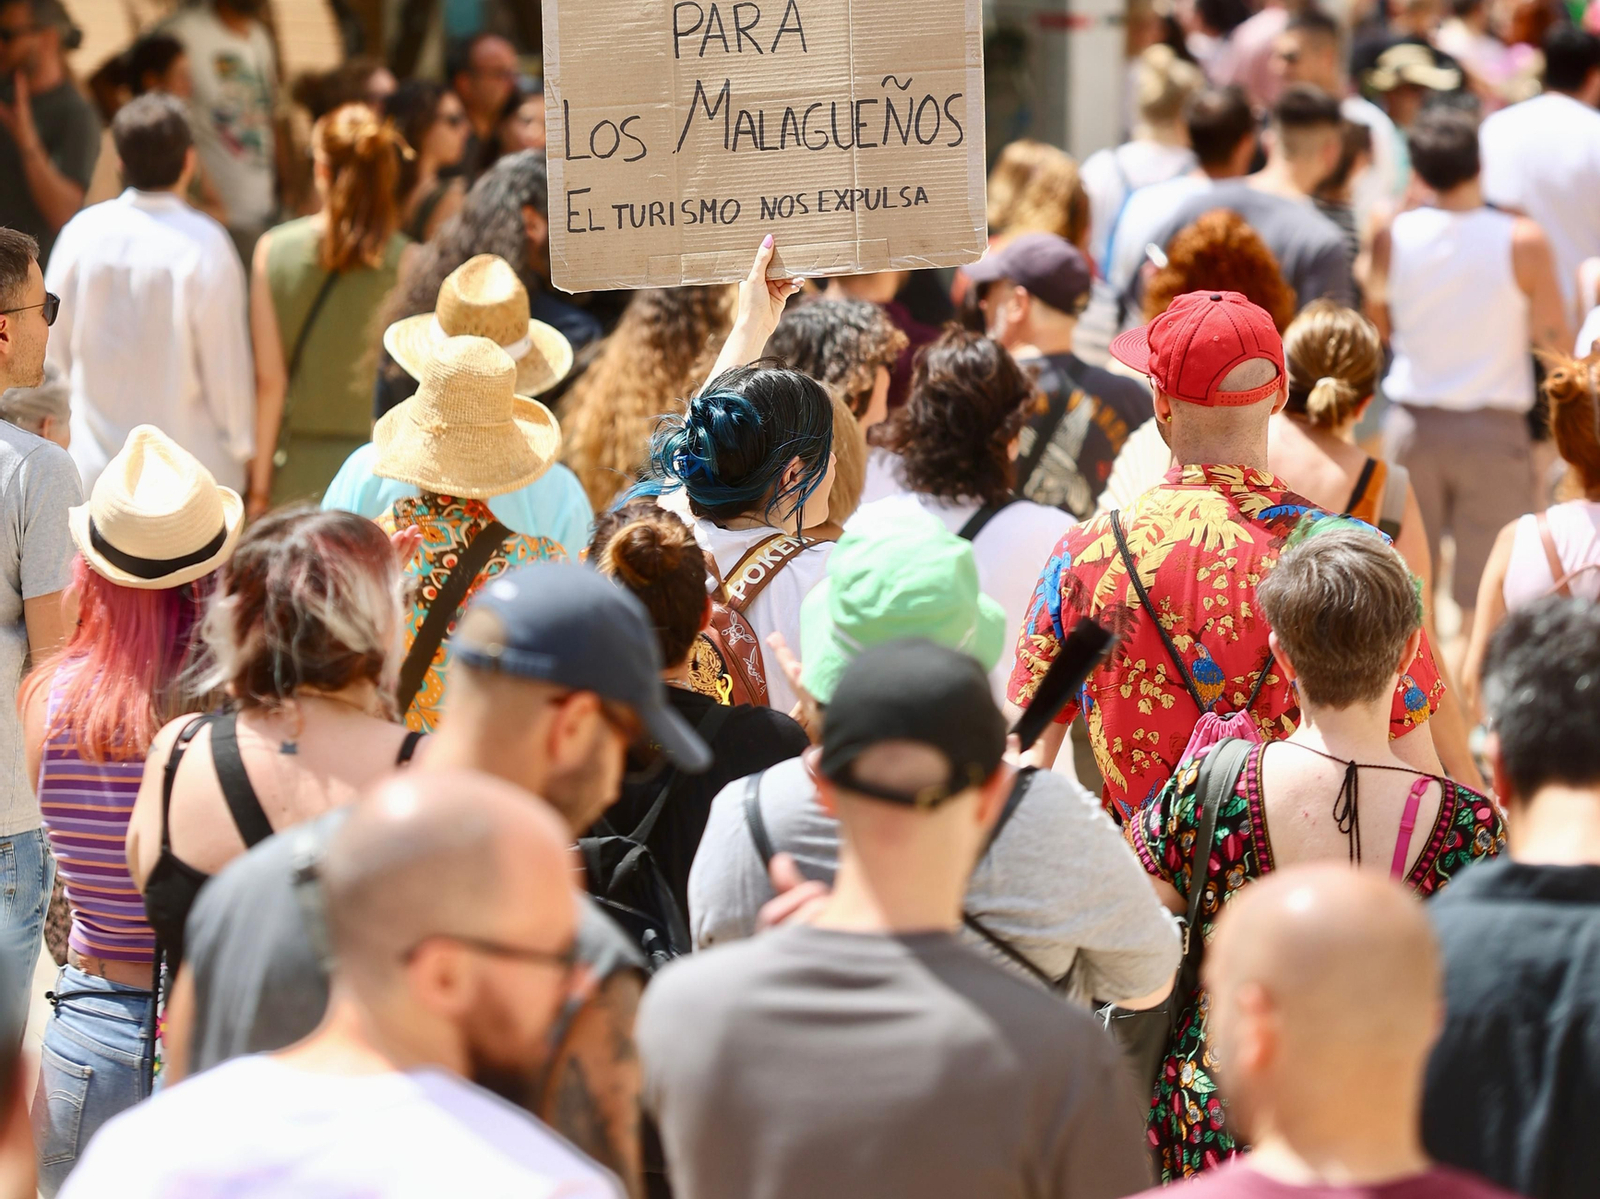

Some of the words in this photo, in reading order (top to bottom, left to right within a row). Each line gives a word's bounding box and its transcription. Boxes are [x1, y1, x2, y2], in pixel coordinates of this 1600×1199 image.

[563, 99, 647, 163] LOS
[672, 75, 964, 154] MALAGUEÑOS
[567, 187, 605, 234] EL
[611, 198, 741, 230] TURISMO
[760, 192, 809, 221] NOS
[818, 186, 929, 213] EXPULSA
